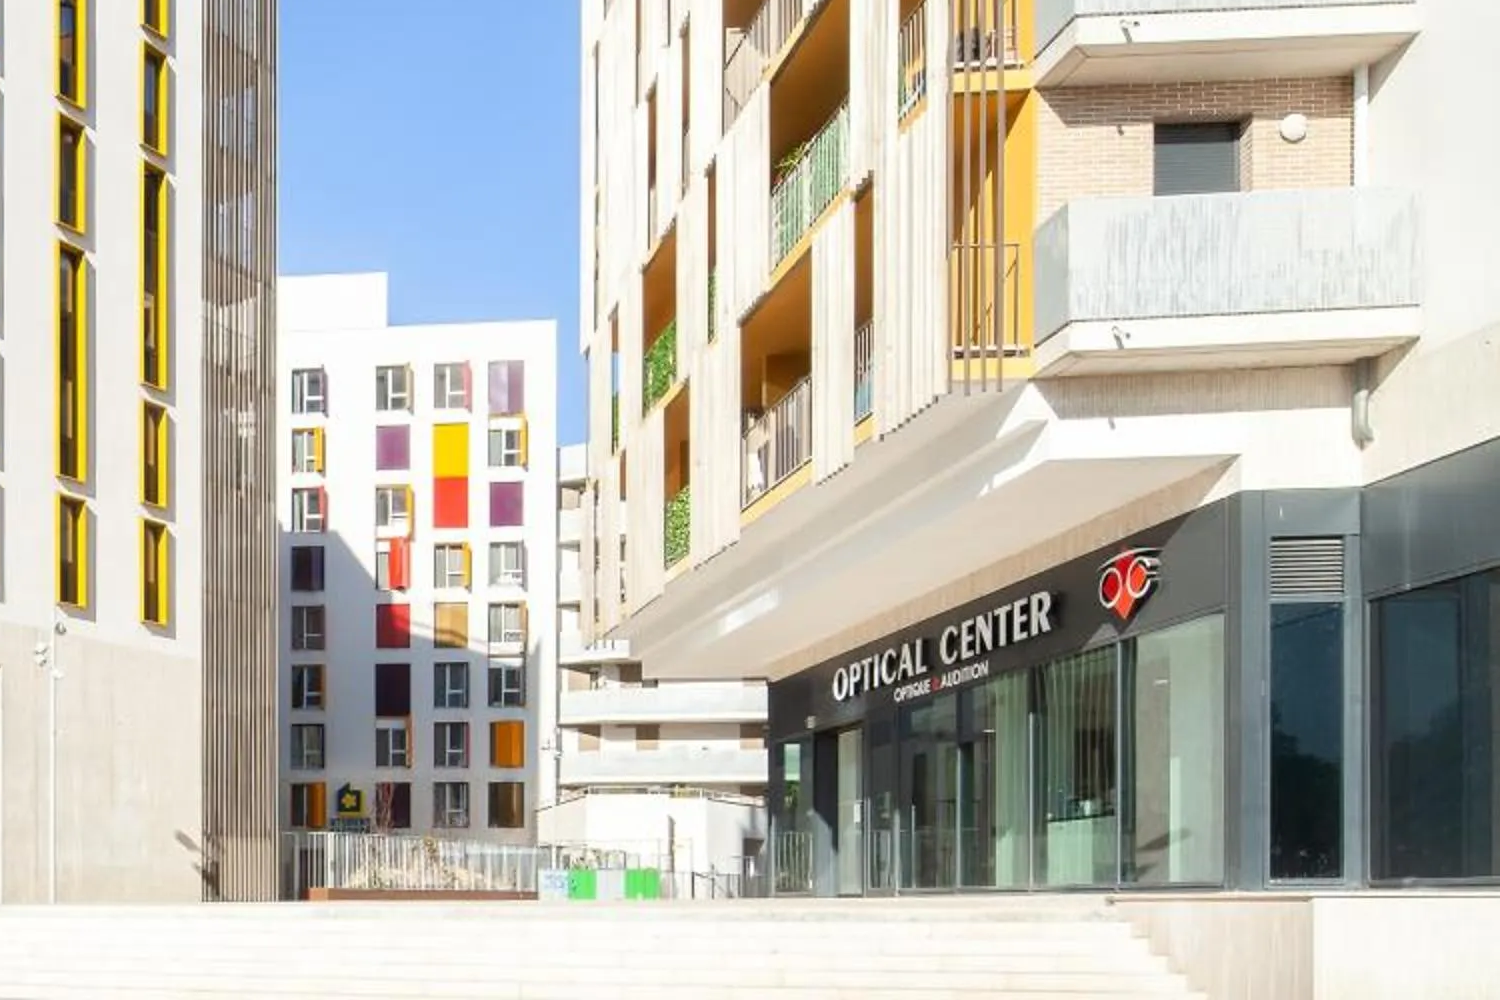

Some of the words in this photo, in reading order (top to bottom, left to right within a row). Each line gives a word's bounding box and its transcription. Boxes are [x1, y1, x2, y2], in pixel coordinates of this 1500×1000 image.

[832, 637, 928, 702] OPTICAL
[939, 590, 1052, 666] CENTER
[893, 677, 931, 703] OPTIQUE
[940, 660, 989, 689] AUDITION
